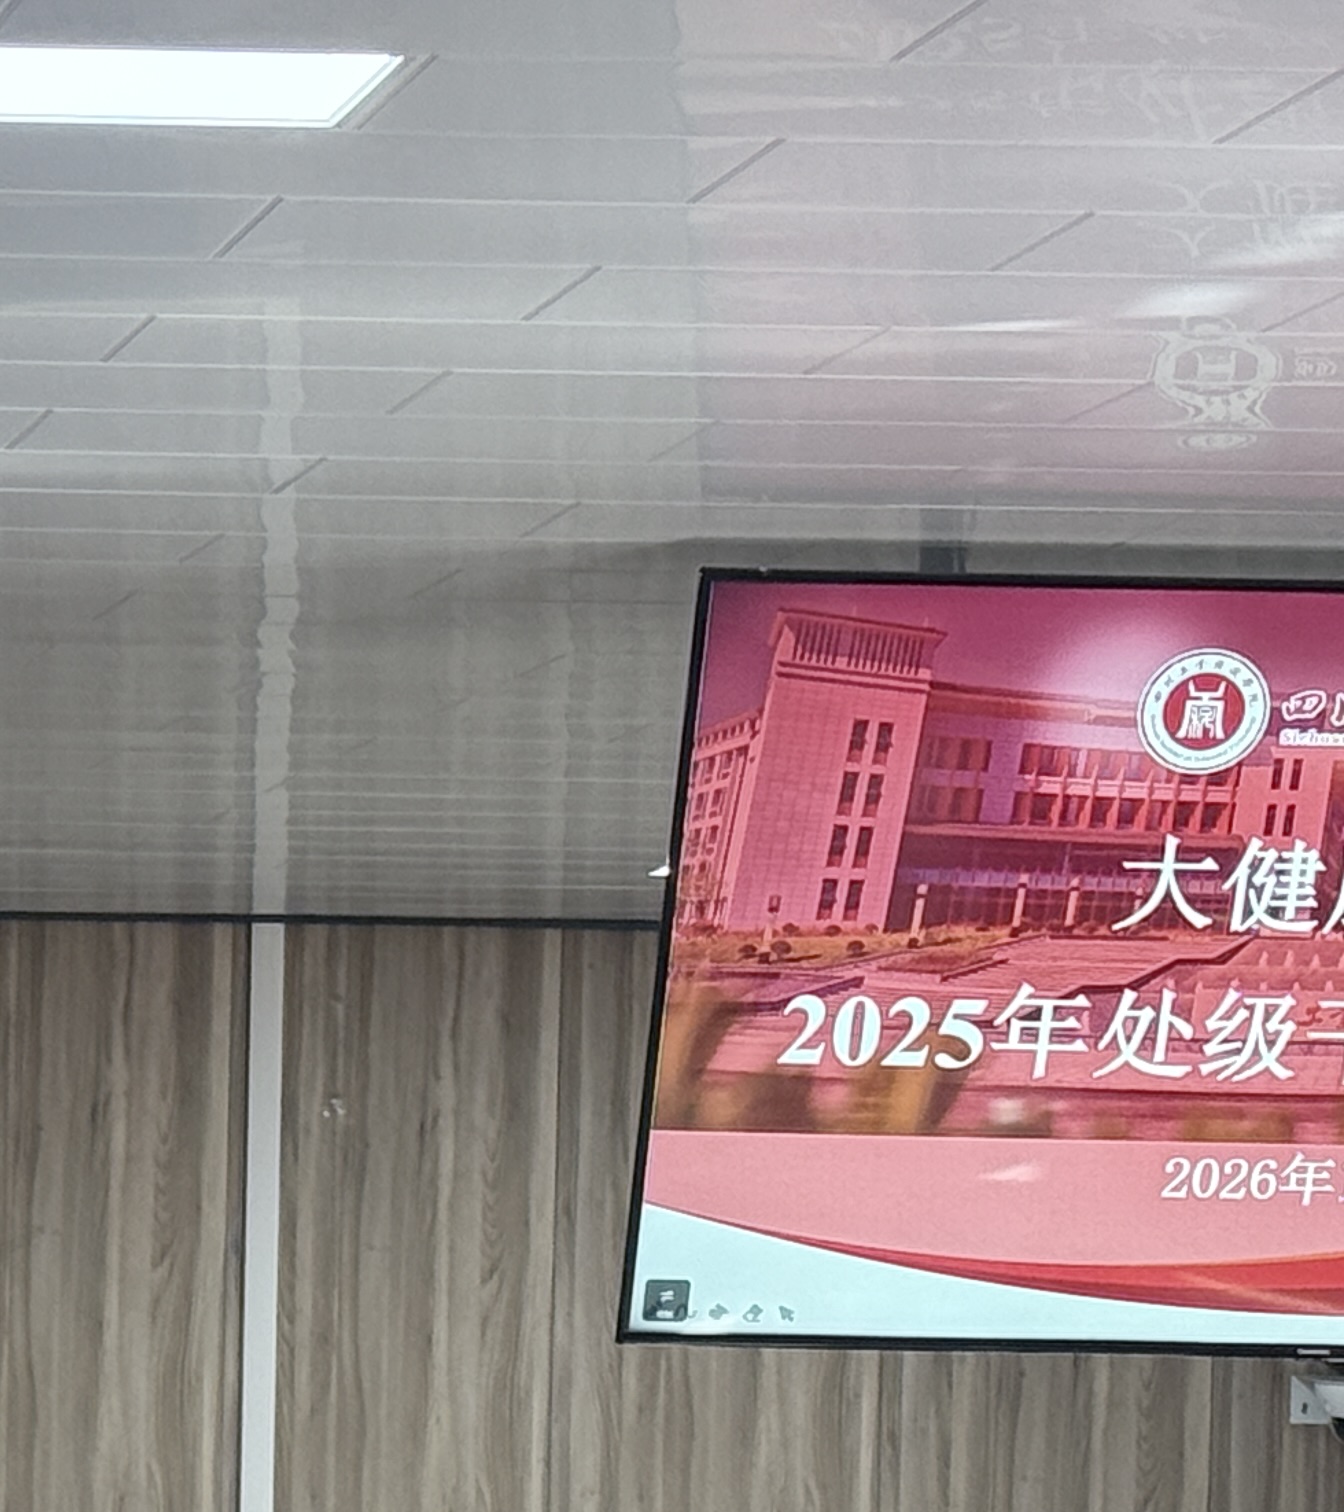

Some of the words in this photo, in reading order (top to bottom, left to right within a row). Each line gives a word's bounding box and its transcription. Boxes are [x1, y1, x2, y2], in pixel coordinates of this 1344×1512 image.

[1281, 690, 1344, 726] 四
[1111, 833, 1344, 935] 大健
[1161, 1152, 1344, 1206] 2026年
